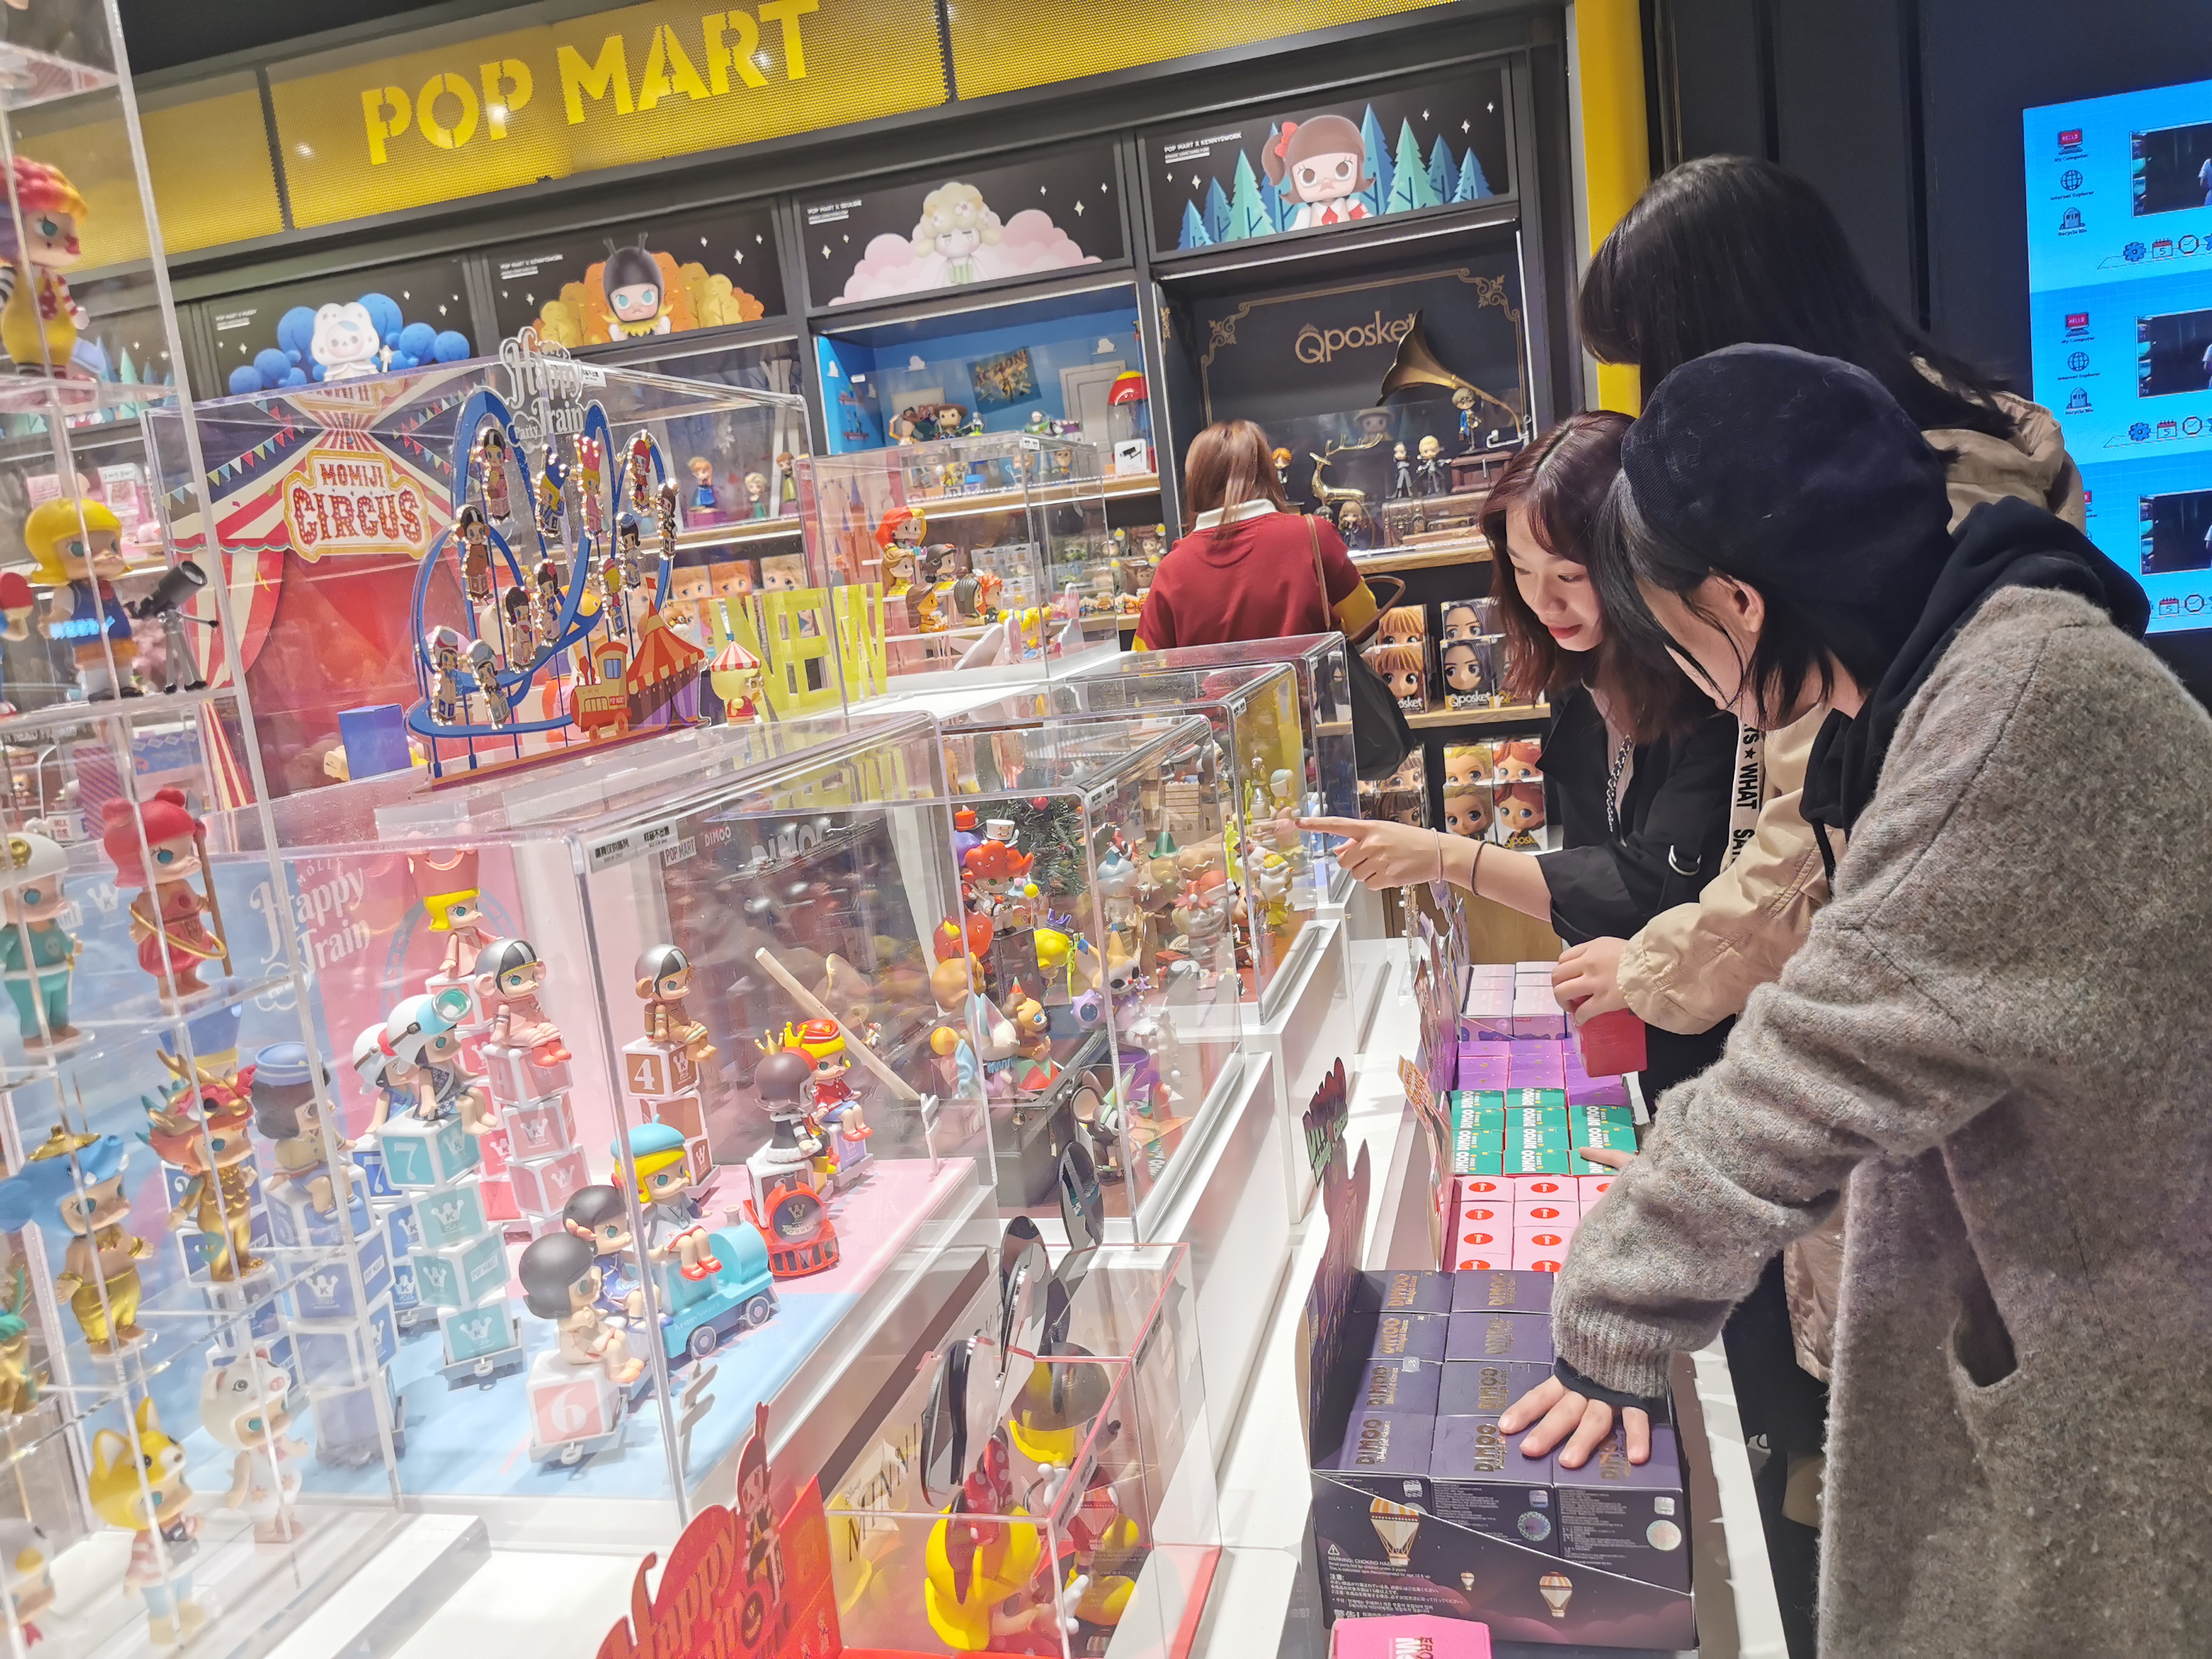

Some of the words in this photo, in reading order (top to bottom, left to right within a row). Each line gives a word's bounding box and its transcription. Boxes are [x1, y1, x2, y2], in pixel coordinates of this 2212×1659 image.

[361, 58, 533, 165] POP
[557, 0, 819, 125] MART
[1178, 141, 1194, 150] MART
[531, 397, 585, 434] Train
[320, 463, 385, 488] MOMIJI
[293, 486, 422, 546] CIRCUS
[709, 582, 887, 722] NEW
[1398, 696, 1423, 708] osket
[1449, 690, 1491, 708] Qposket
[1743, 723, 1760, 745] YS
[1736, 762, 1758, 809] WHAT
[705, 826, 731, 847] DIMOO
[666, 847, 678, 863] POP
[679, 838, 695, 859] MART
[250, 867, 364, 964] Happy
[297, 917, 371, 973] Train
[634, 1059, 655, 1090] 4
[1461, 1090, 1474, 1108] DIMOO
[1522, 1088, 1535, 1106] DIMOO
[1460, 1109, 1475, 1128] DIMOO
[1523, 1108, 1536, 1127] DIMOO
[1586, 1105, 1601, 1126] DIMOO
[1456, 1130, 1472, 1151] DIMOO
[1523, 1128, 1537, 1149] DIMOO
[1587, 1128, 1604, 1148] DIMOO
[394, 1142, 417, 1181] 7
[1455, 1151, 1470, 1173] DIMOO
[1521, 1150, 1537, 1172] DIMOO
[1589, 1161, 1604, 1174] DIM
[364, 1156, 384, 1193] 7
[1366, 1365, 1390, 1406] DIMOO
[1478, 1366, 1498, 1409] DIMOO
[551, 1387, 588, 1433] 6
[1355, 1418, 1382, 1465] DIMOO
[1473, 1423, 1496, 1472] DIMOO
[848, 1416, 920, 1562] MINNI
